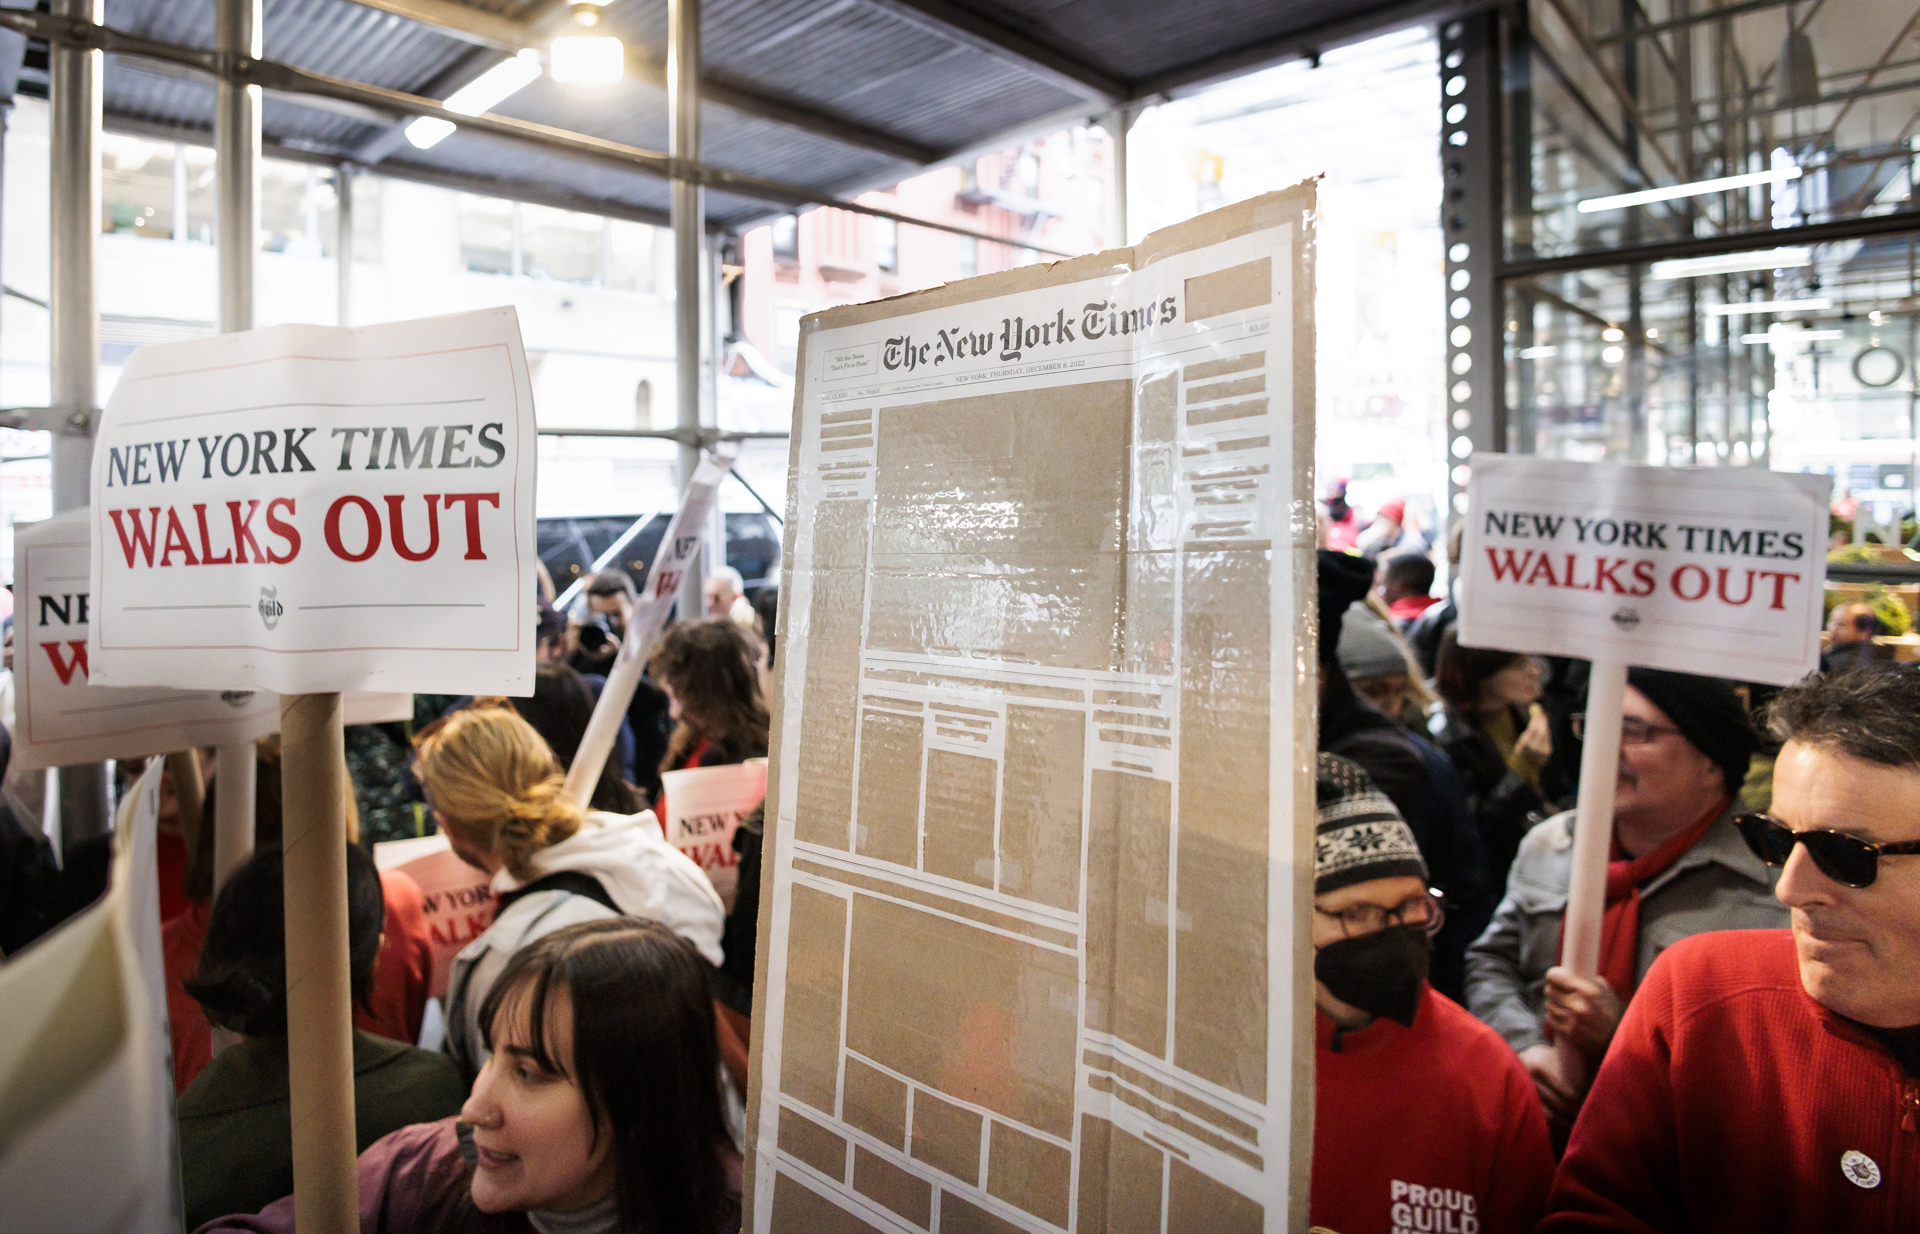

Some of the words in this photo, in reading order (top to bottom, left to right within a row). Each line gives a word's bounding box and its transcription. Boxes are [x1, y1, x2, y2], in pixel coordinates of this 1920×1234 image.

[883, 333, 931, 373] The
[934, 325, 994, 367] New
[999, 308, 1076, 362] York
[1081, 296, 1177, 341] Times
[955, 375, 970, 383] NEW
[970, 373, 988, 381] YORK,
[990, 368, 1024, 378] THURSDAY,
[1026, 363, 1061, 373] DECEMBER
[1070, 360, 1085, 368] 2022
[107, 438, 190, 488] NEW
[197, 427, 317, 479] YORK
[330, 422, 507, 471] TIMES
[108, 497, 301, 570] WALKS
[324, 492, 500, 563] OUT
[1484, 511, 1565, 541] NEW
[1573, 518, 1669, 552] YORK
[1677, 524, 1805, 561] TIMES
[1484, 546, 1657, 598] WALKS
[1669, 563, 1800, 612] OUT
[1390, 1178, 1477, 1215] PROUD
[1390, 1201, 1480, 1234] GUILD
